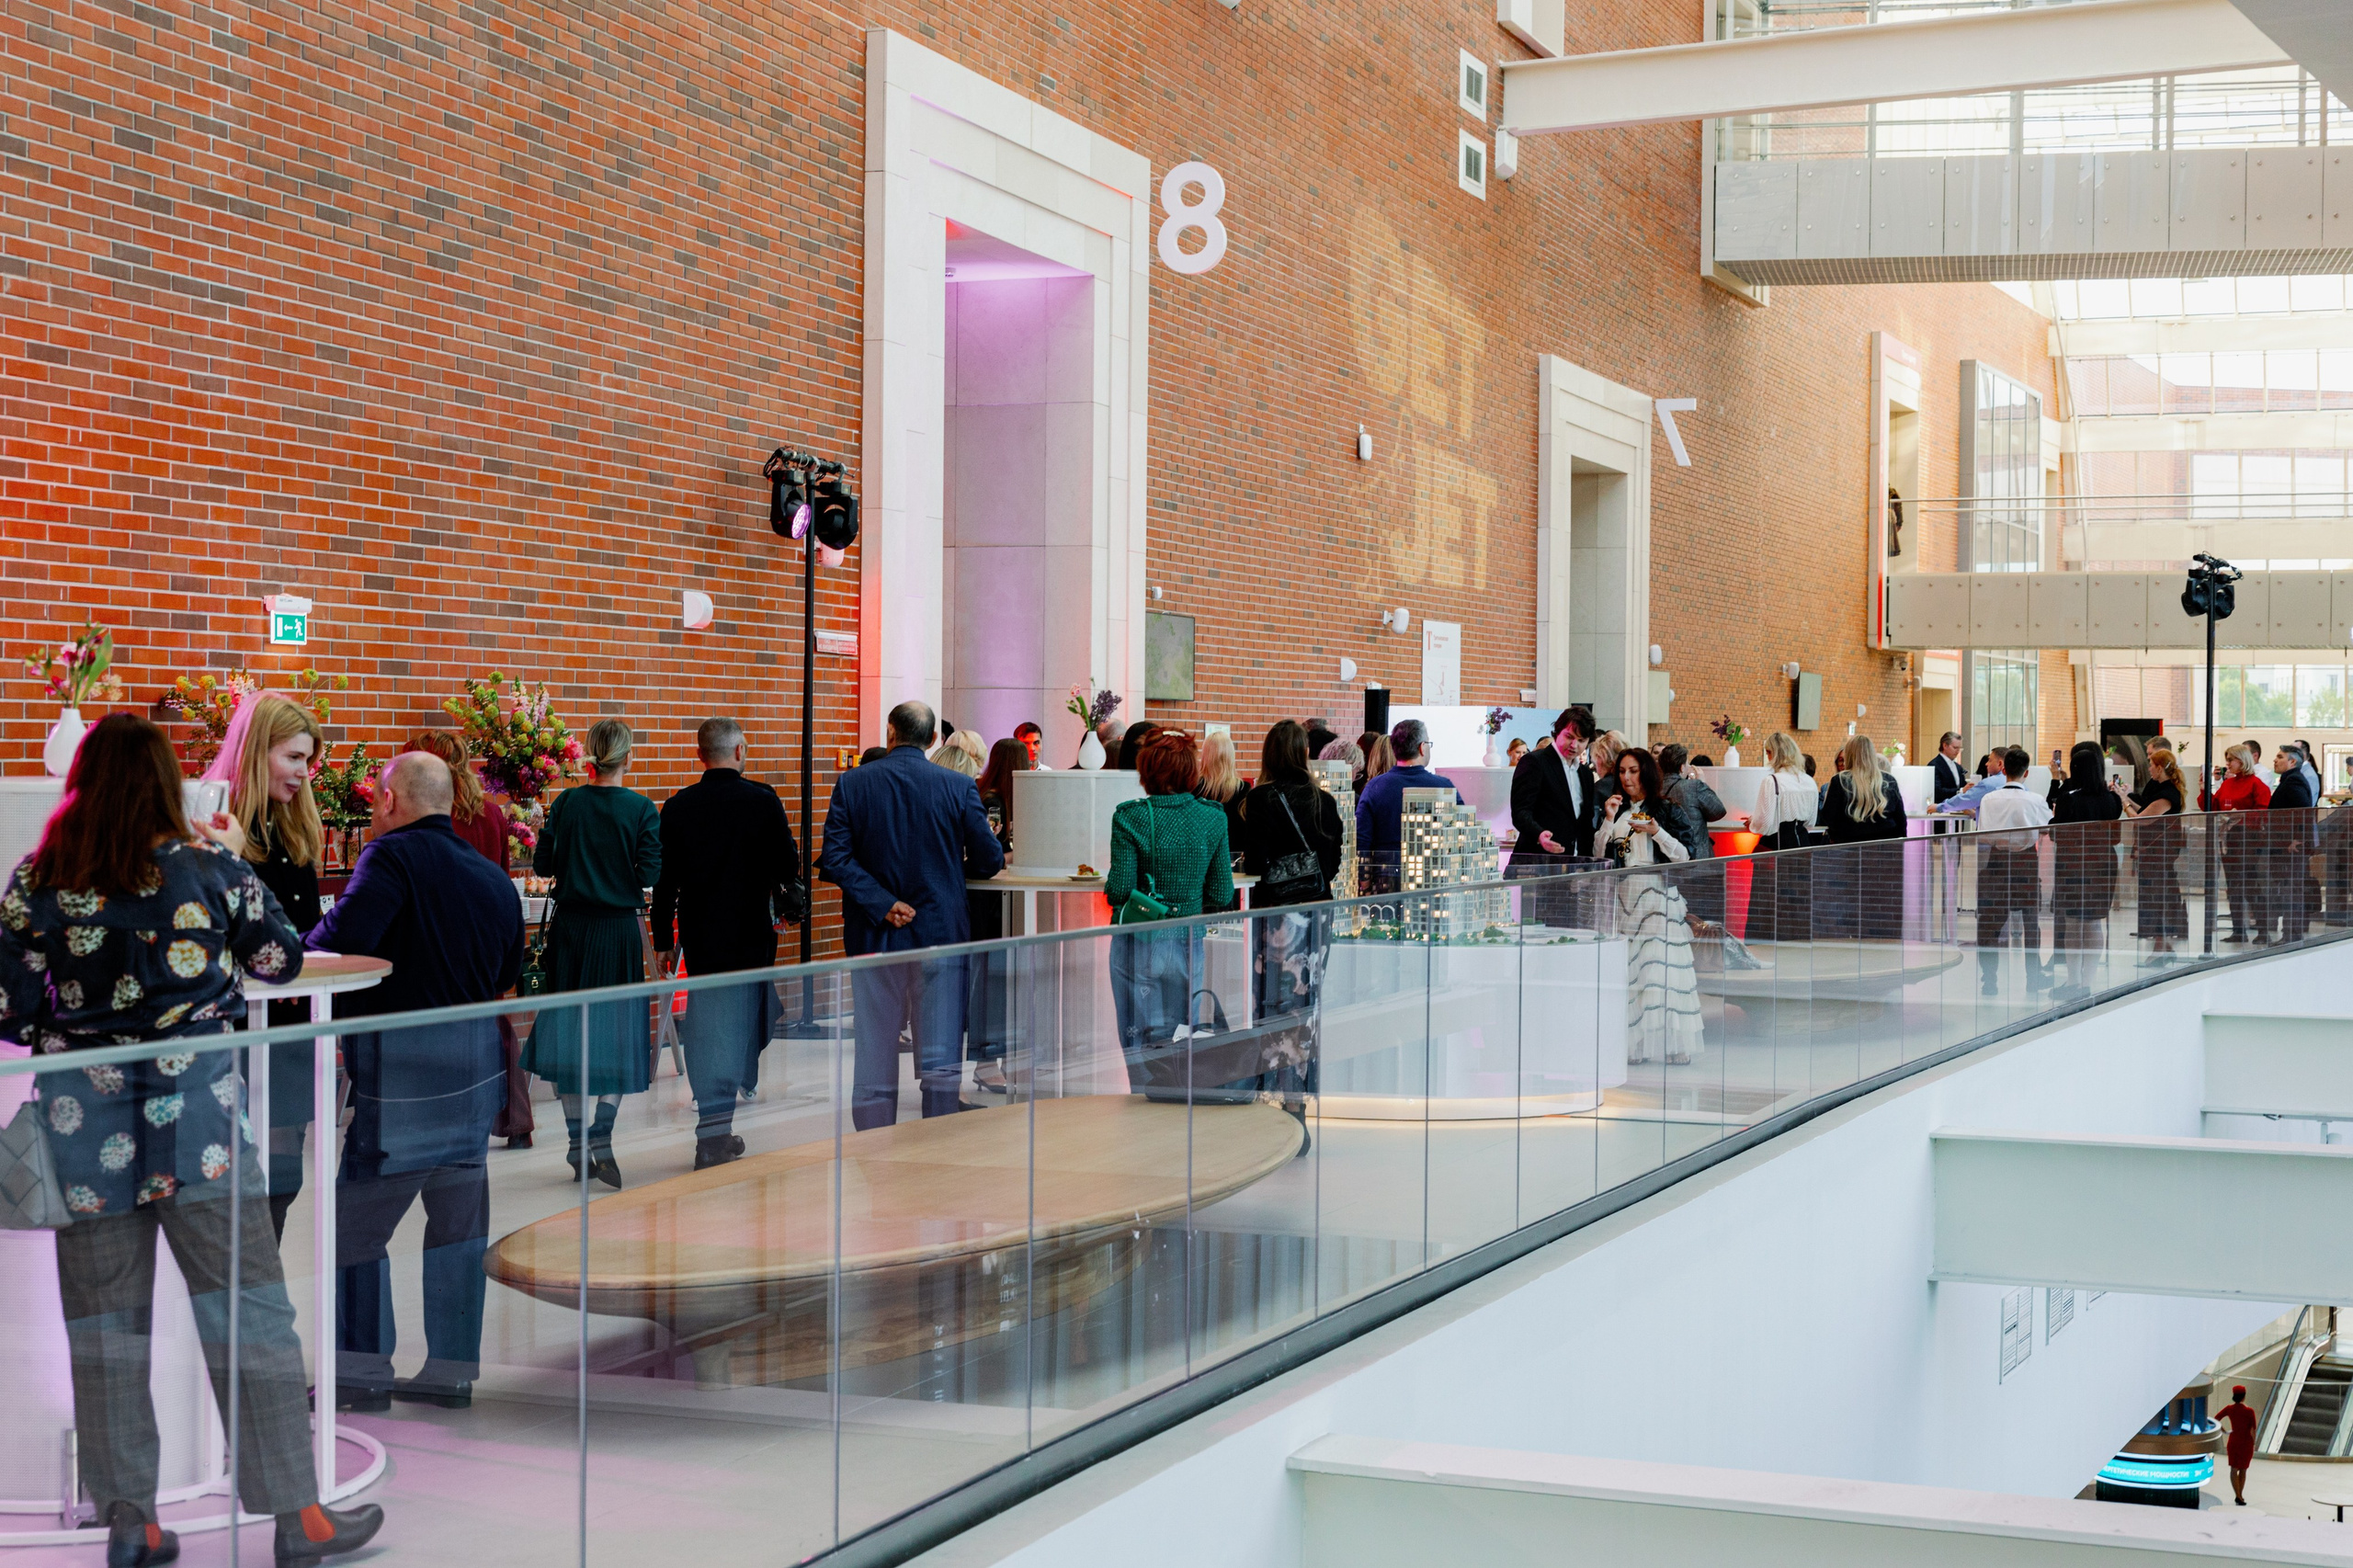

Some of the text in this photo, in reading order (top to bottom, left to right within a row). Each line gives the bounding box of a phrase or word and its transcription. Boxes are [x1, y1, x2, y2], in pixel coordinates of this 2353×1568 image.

[1157, 161, 1227, 275] 8
[1350, 203, 1484, 443] GET
[1384, 442, 1499, 590] JET
[2150, 1471, 2190, 1479] МОЩНОСТИ
